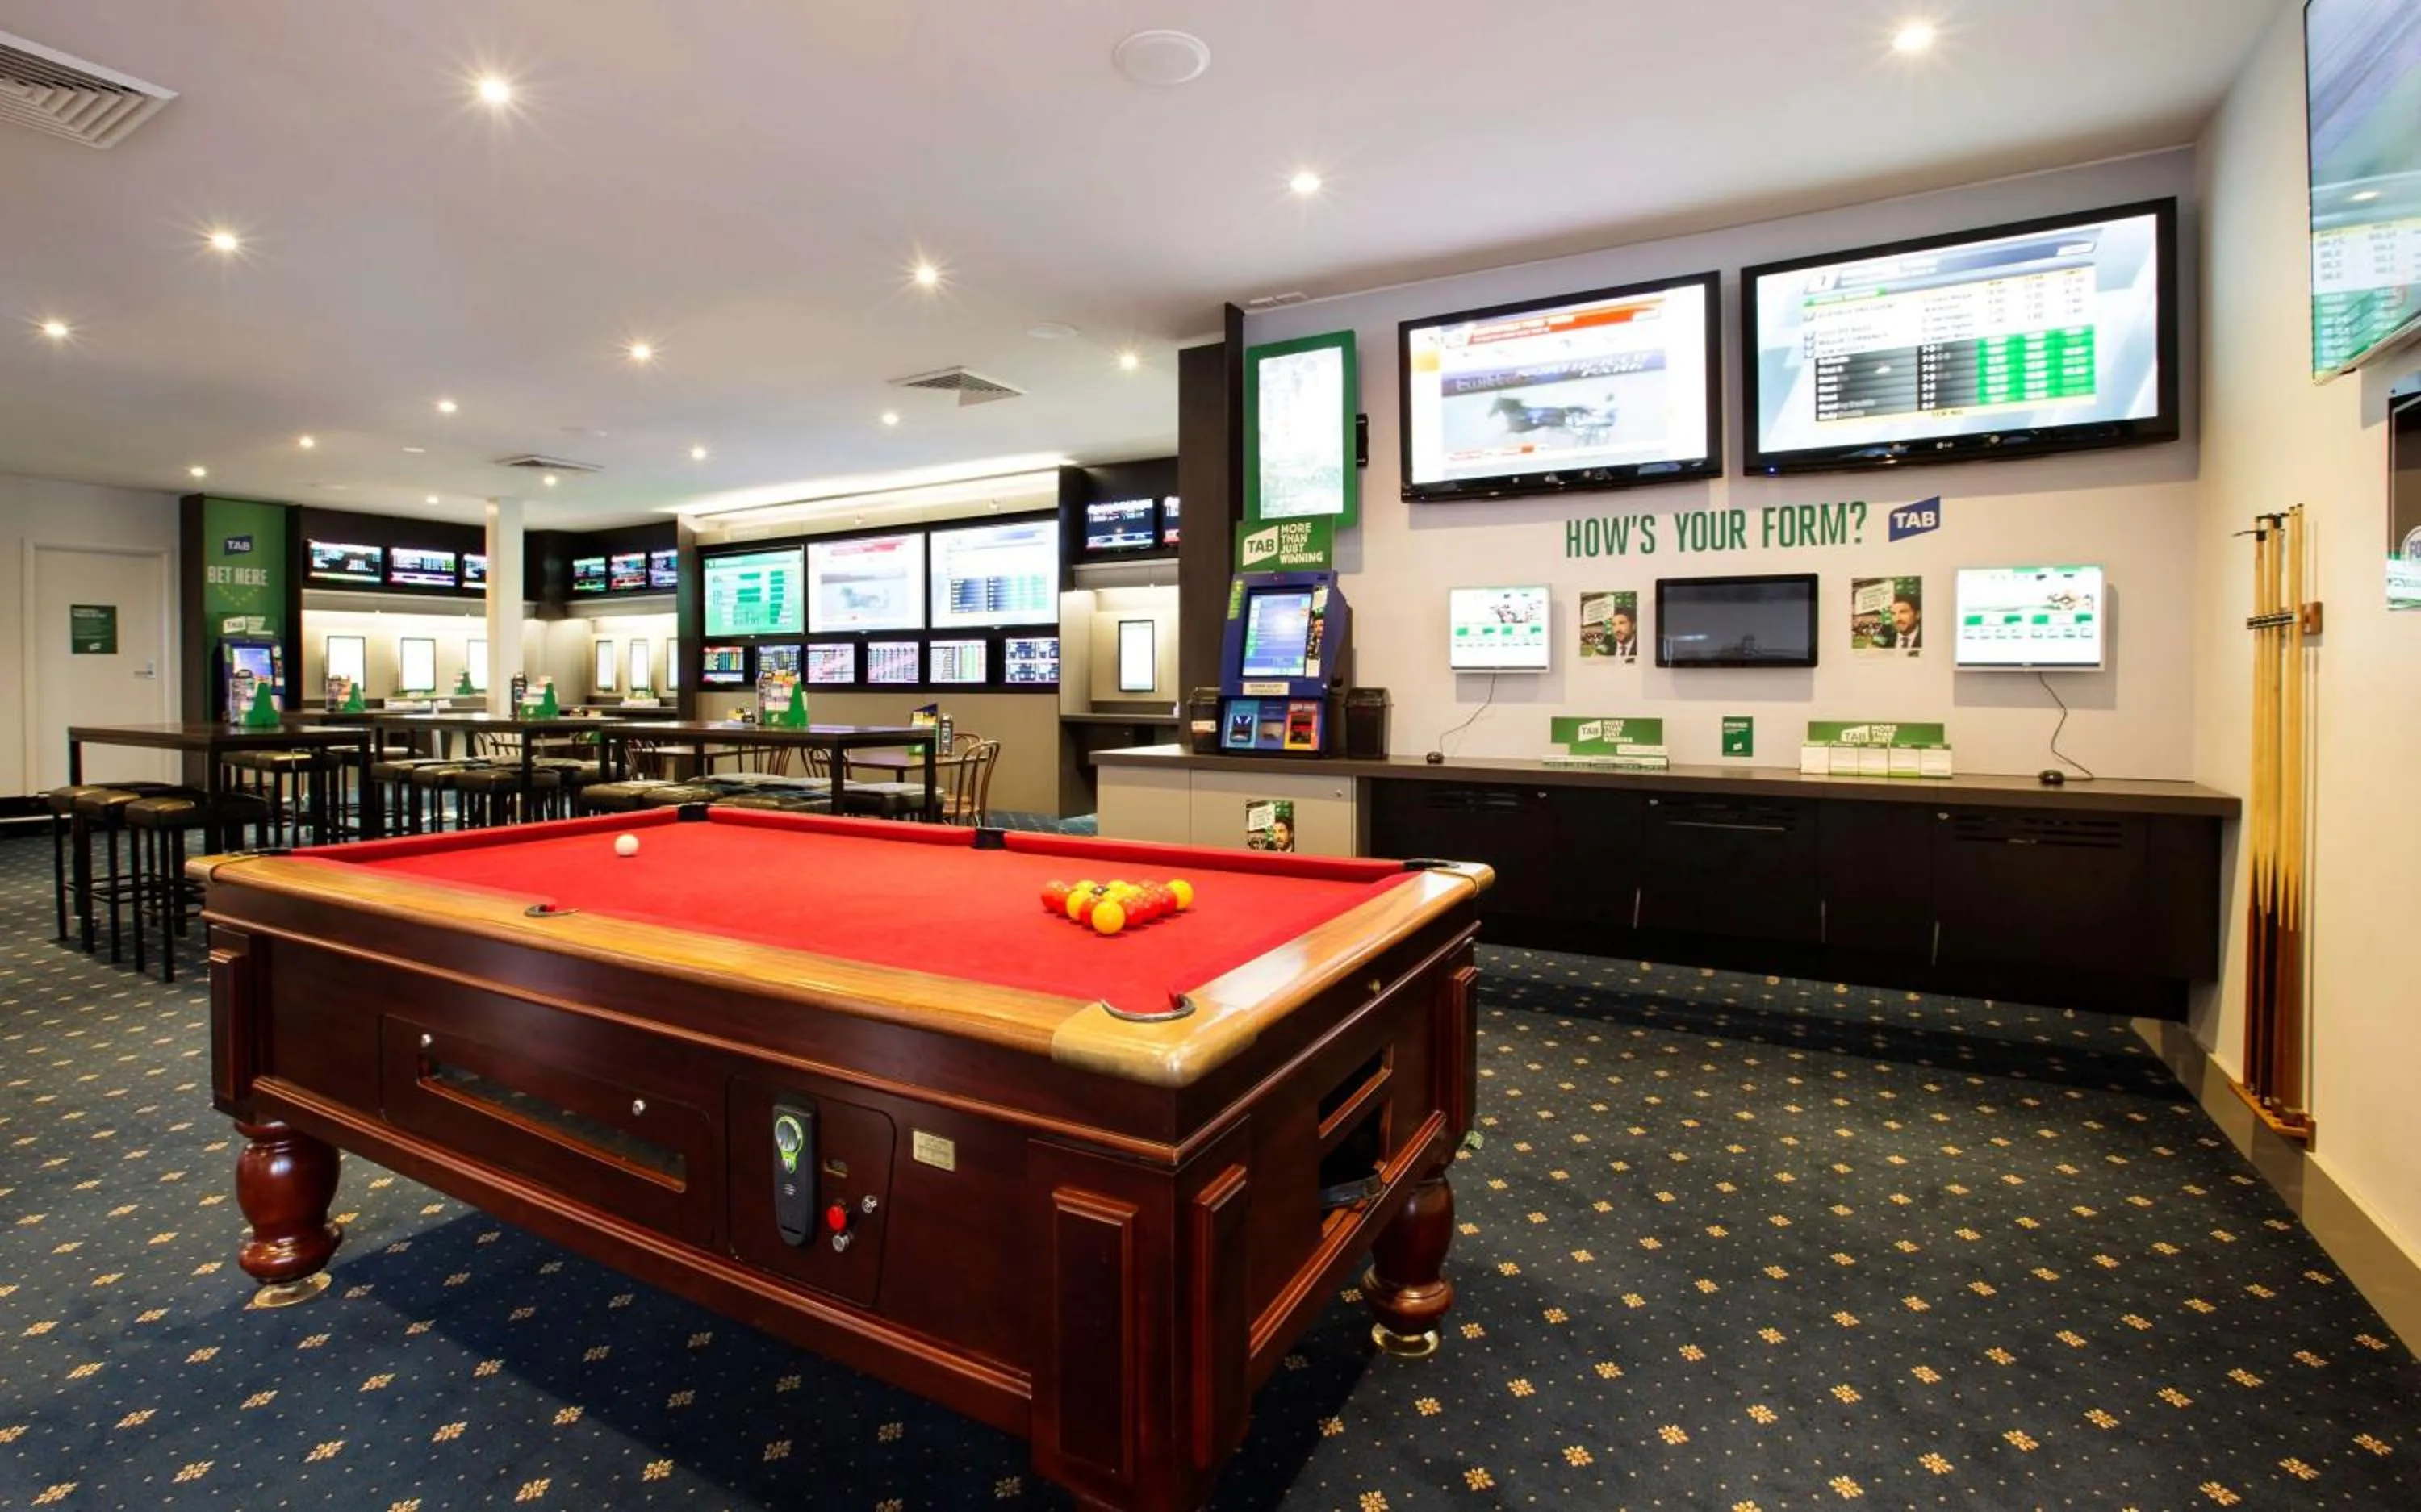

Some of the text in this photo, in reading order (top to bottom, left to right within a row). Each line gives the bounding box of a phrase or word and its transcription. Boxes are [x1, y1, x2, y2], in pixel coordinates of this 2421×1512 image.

[1892, 510, 1936, 529] TAB
[1280, 522, 1312, 534] MORE
[1566, 501, 1867, 558] HOW'S YOUR FORM?
[1280, 533, 1307, 544] THAN
[227, 540, 251, 551] TAB
[1247, 538, 1275, 553] TAB
[1280, 543, 1305, 554] JUST
[1279, 551, 1323, 564] WINNING
[207, 566, 269, 587] BET HERE
[1582, 727, 1599, 735] TAB
[1846, 732, 1867, 742] TAB
